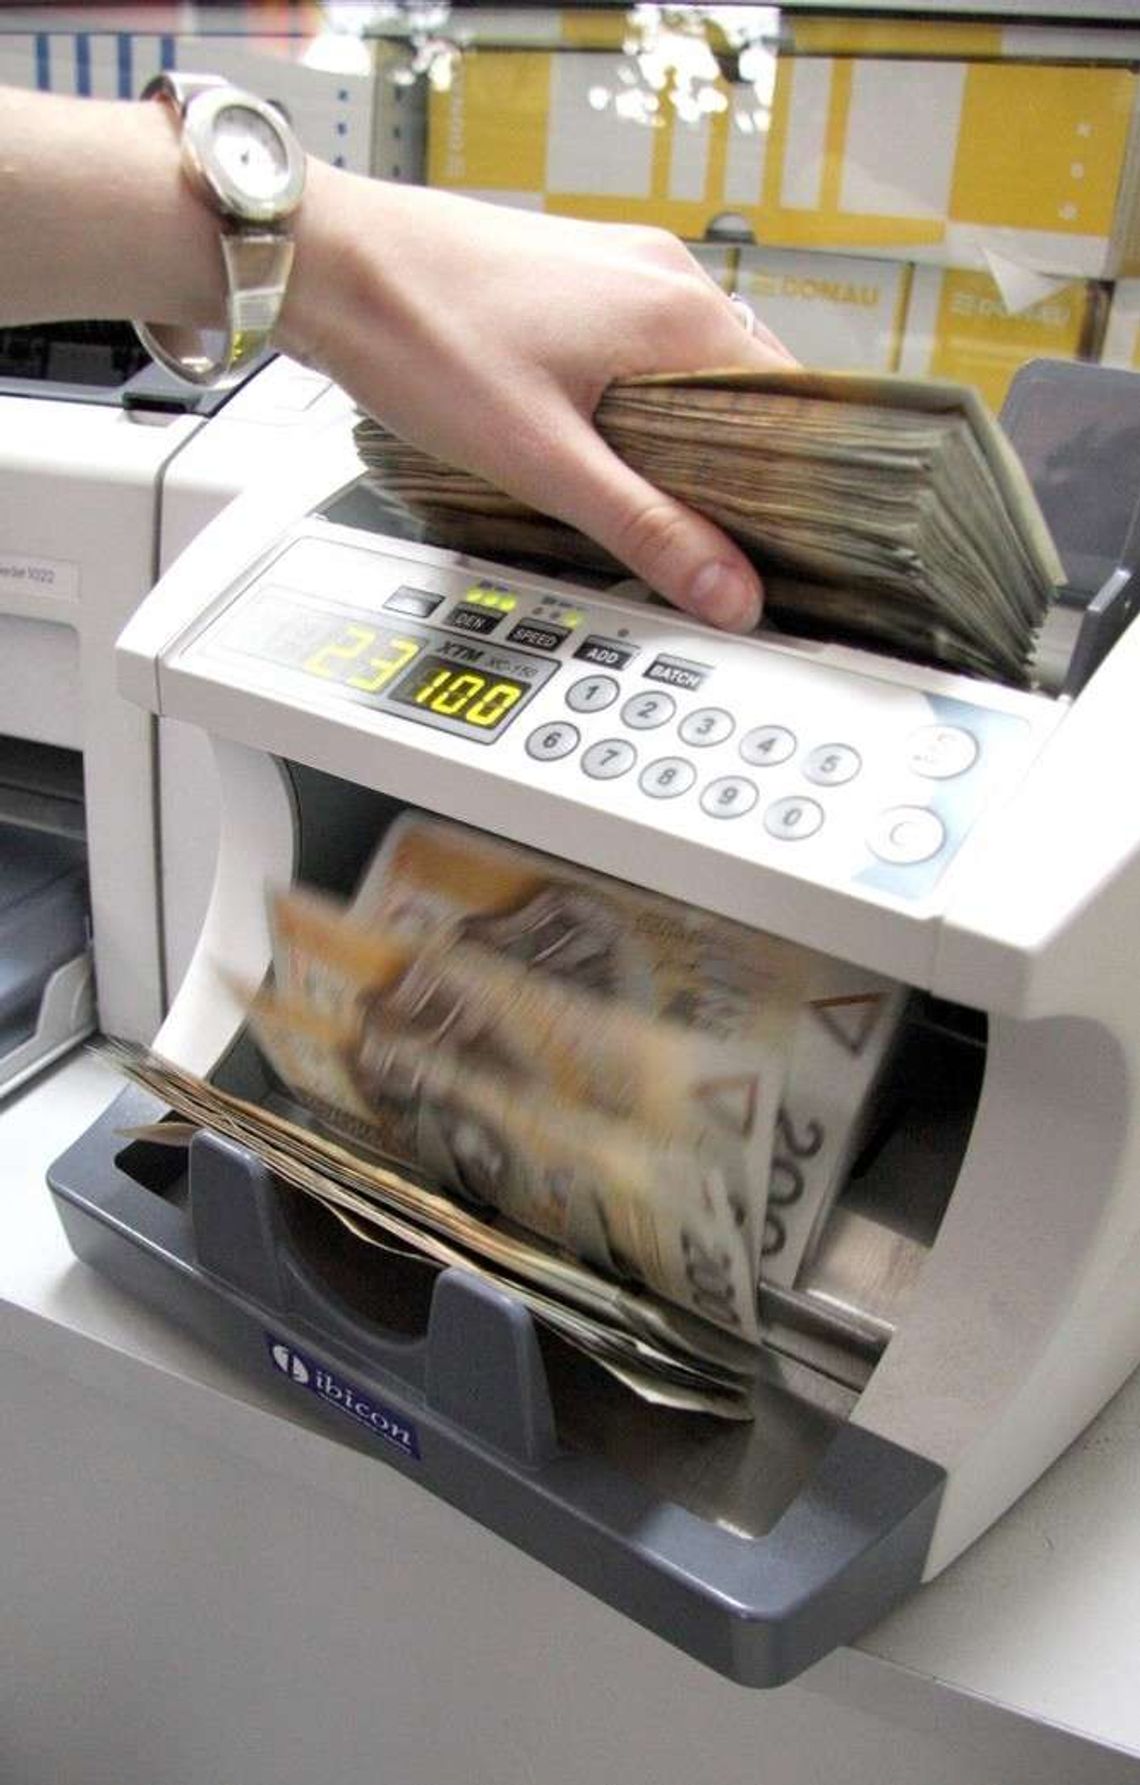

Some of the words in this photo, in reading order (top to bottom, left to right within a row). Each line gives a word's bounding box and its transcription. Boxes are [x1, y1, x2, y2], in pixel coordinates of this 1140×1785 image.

[783, 273, 880, 306] DONAU
[454, 611, 484, 630] DEN
[512, 626, 559, 648] SPEED
[303, 622, 421, 694] 23
[435, 640, 486, 662] XTM
[587, 647, 619, 665] ADD
[649, 663, 699, 688] BATCH
[414, 670, 522, 726] 100
[638, 702, 656, 719] 2
[697, 718, 714, 735] 3
[757, 736, 775, 753] 4
[820, 755, 837, 773] 5
[542, 732, 558, 749] 6
[601, 749, 618, 767] 7
[658, 768, 674, 785] 8
[719, 788, 736, 805] 9
[782, 807, 802, 827] 0
[759, 1109, 825, 1257] 200
[315, 1370, 412, 1446] ibicon
